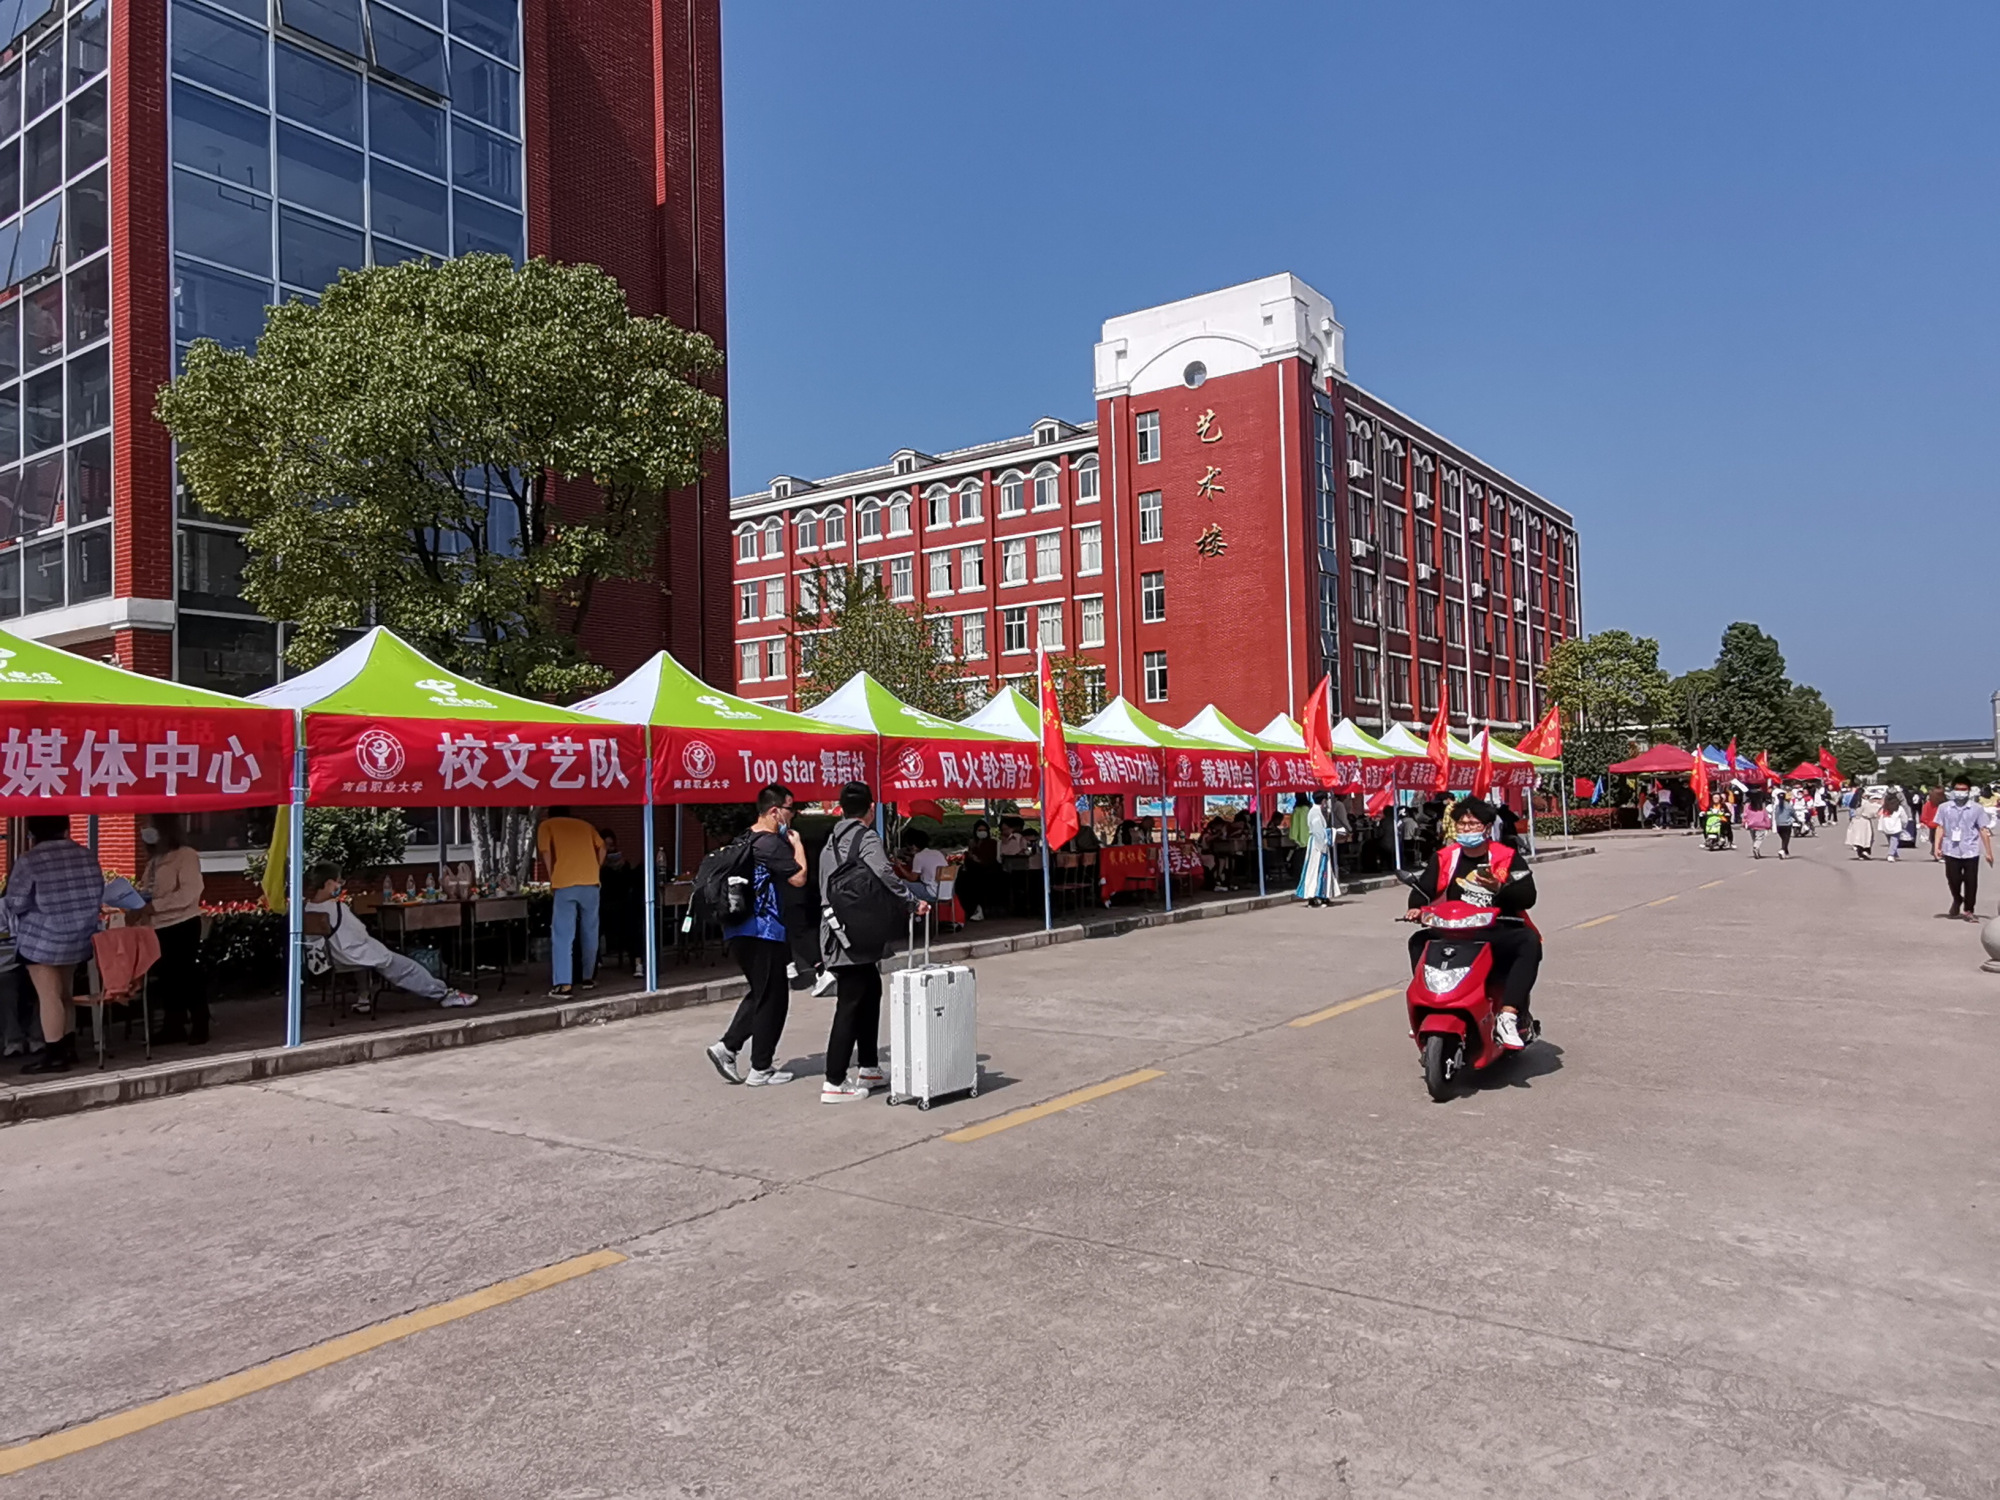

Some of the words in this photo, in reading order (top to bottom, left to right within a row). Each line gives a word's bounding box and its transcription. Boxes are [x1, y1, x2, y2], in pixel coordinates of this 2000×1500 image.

[1195, 408, 1228, 558] 艺术楼
[437, 731, 631, 790] 校文艺队
[738, 750, 777, 784] Top
[783, 754, 816, 783] star
[819, 748, 868, 787] 舞蹈社
[938, 751, 1033, 790] 风火轮滑社
[1091, 750, 1160, 786] 演讲与口才协会
[341, 780, 424, 793] 南昌职业大学
